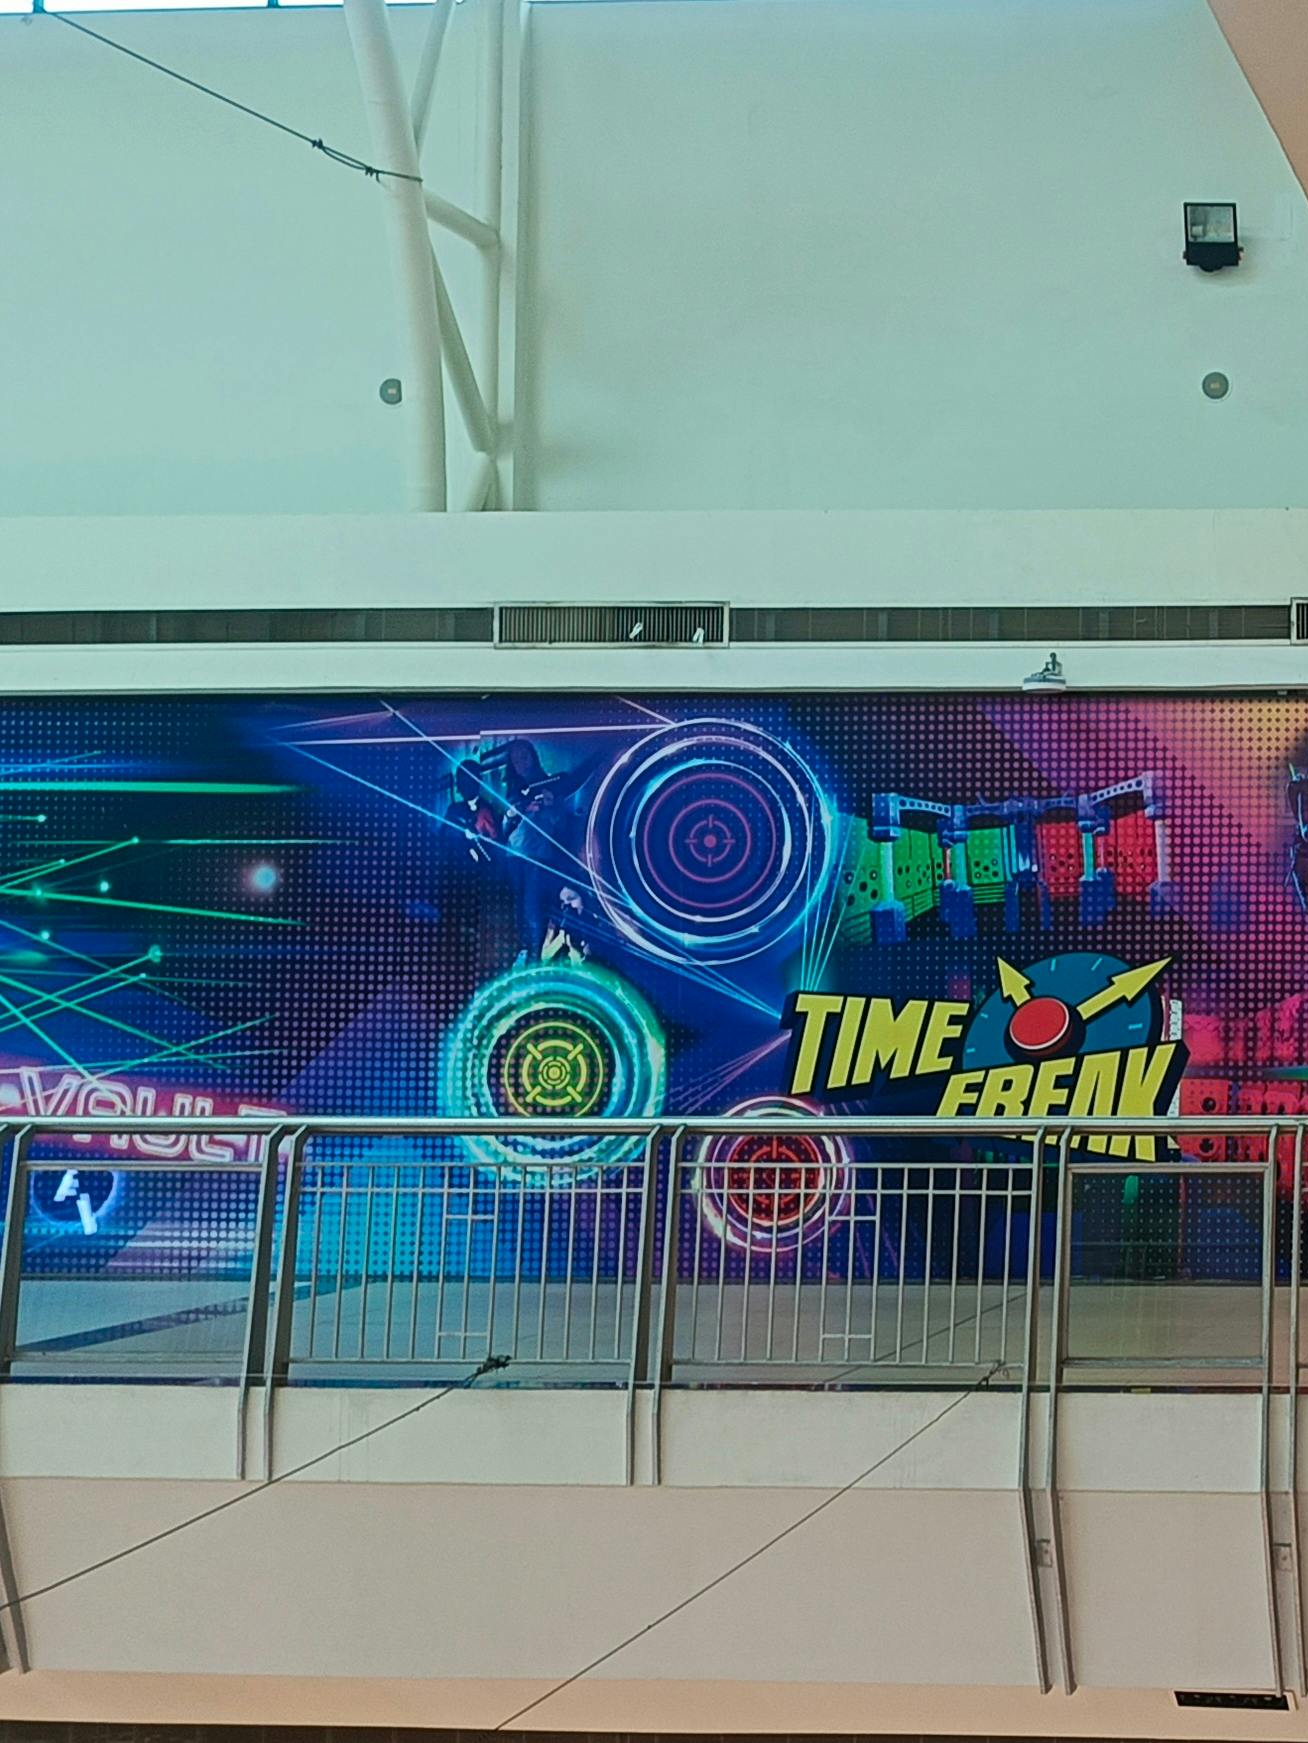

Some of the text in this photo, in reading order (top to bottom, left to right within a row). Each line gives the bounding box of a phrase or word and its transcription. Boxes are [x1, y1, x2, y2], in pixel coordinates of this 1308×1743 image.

[790, 993, 971, 1096] TIME
[19, 1066, 289, 1163] VAULT
[935, 1042, 1177, 1162] FREAK
